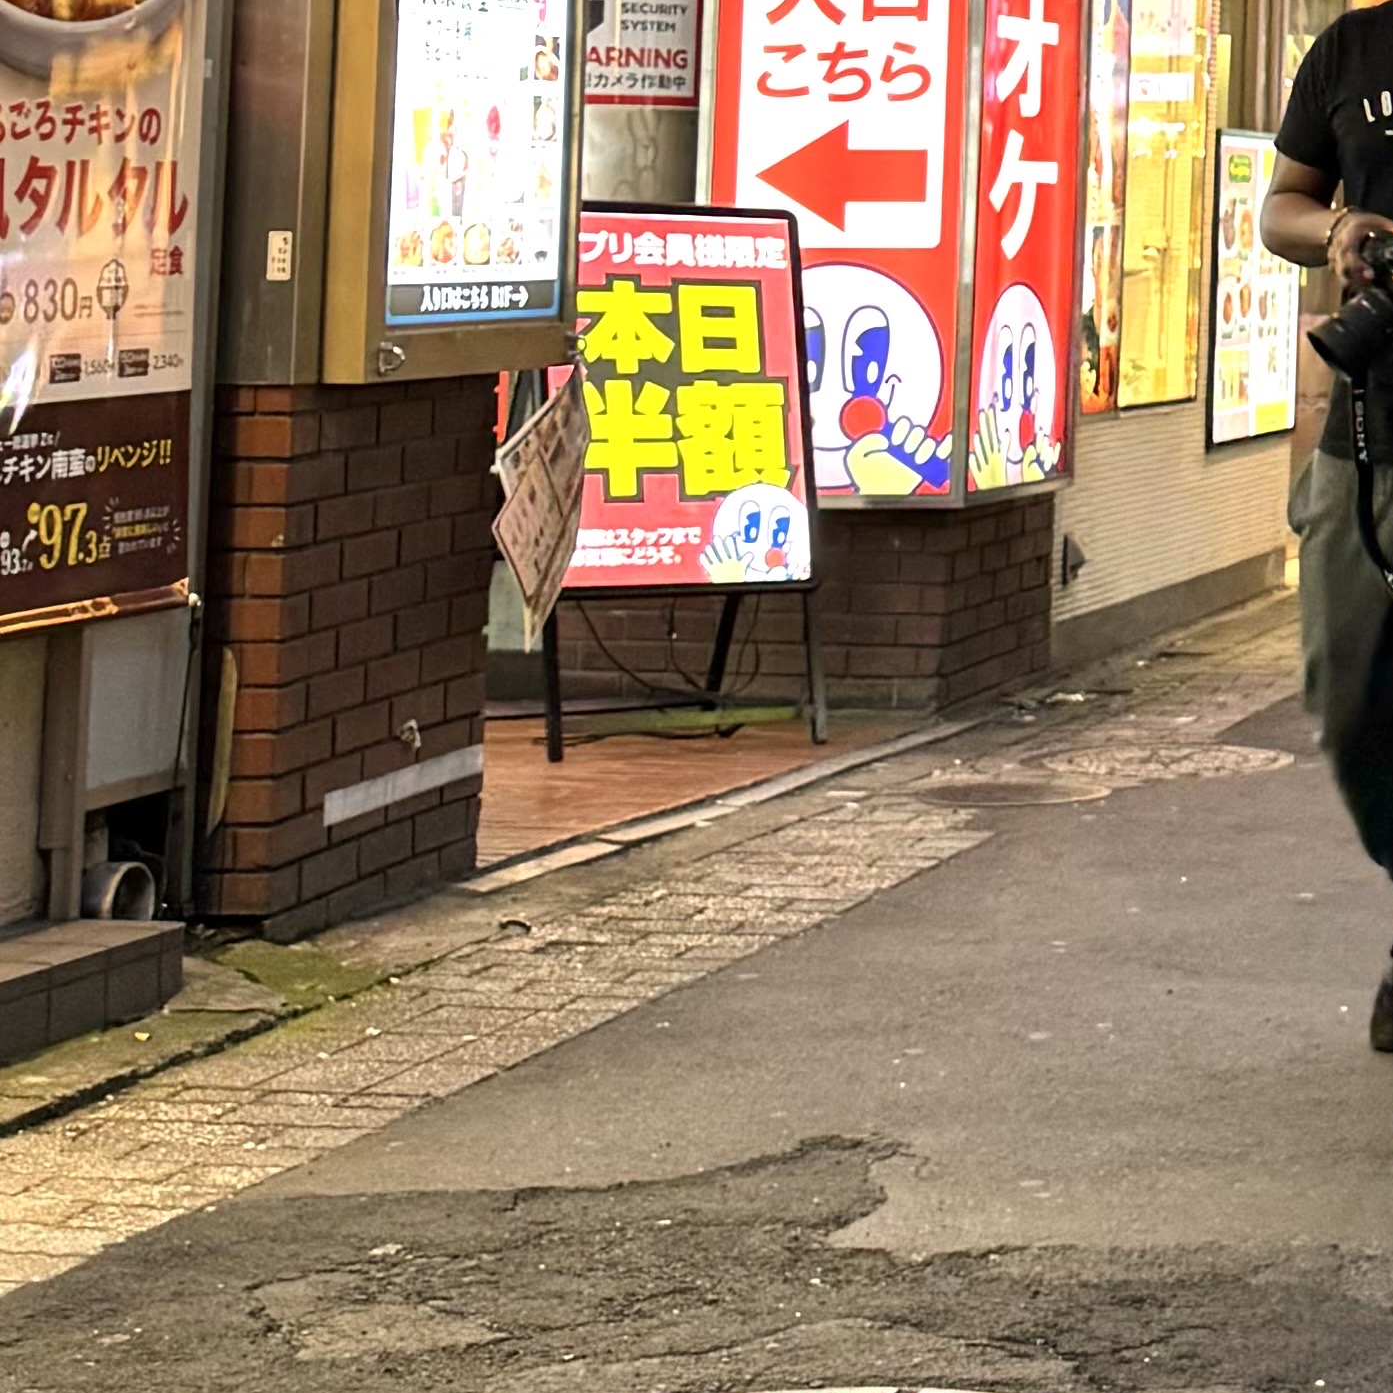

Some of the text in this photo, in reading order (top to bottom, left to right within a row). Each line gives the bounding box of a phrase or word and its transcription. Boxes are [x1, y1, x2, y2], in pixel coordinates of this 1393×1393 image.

[621, 2, 689, 16] SECURITY
[621, 19, 676, 33] SYSTEM
[756, 41, 932, 102] こちら
[577, 280, 761, 374] 本日
[584, 380, 790, 498] 半額
